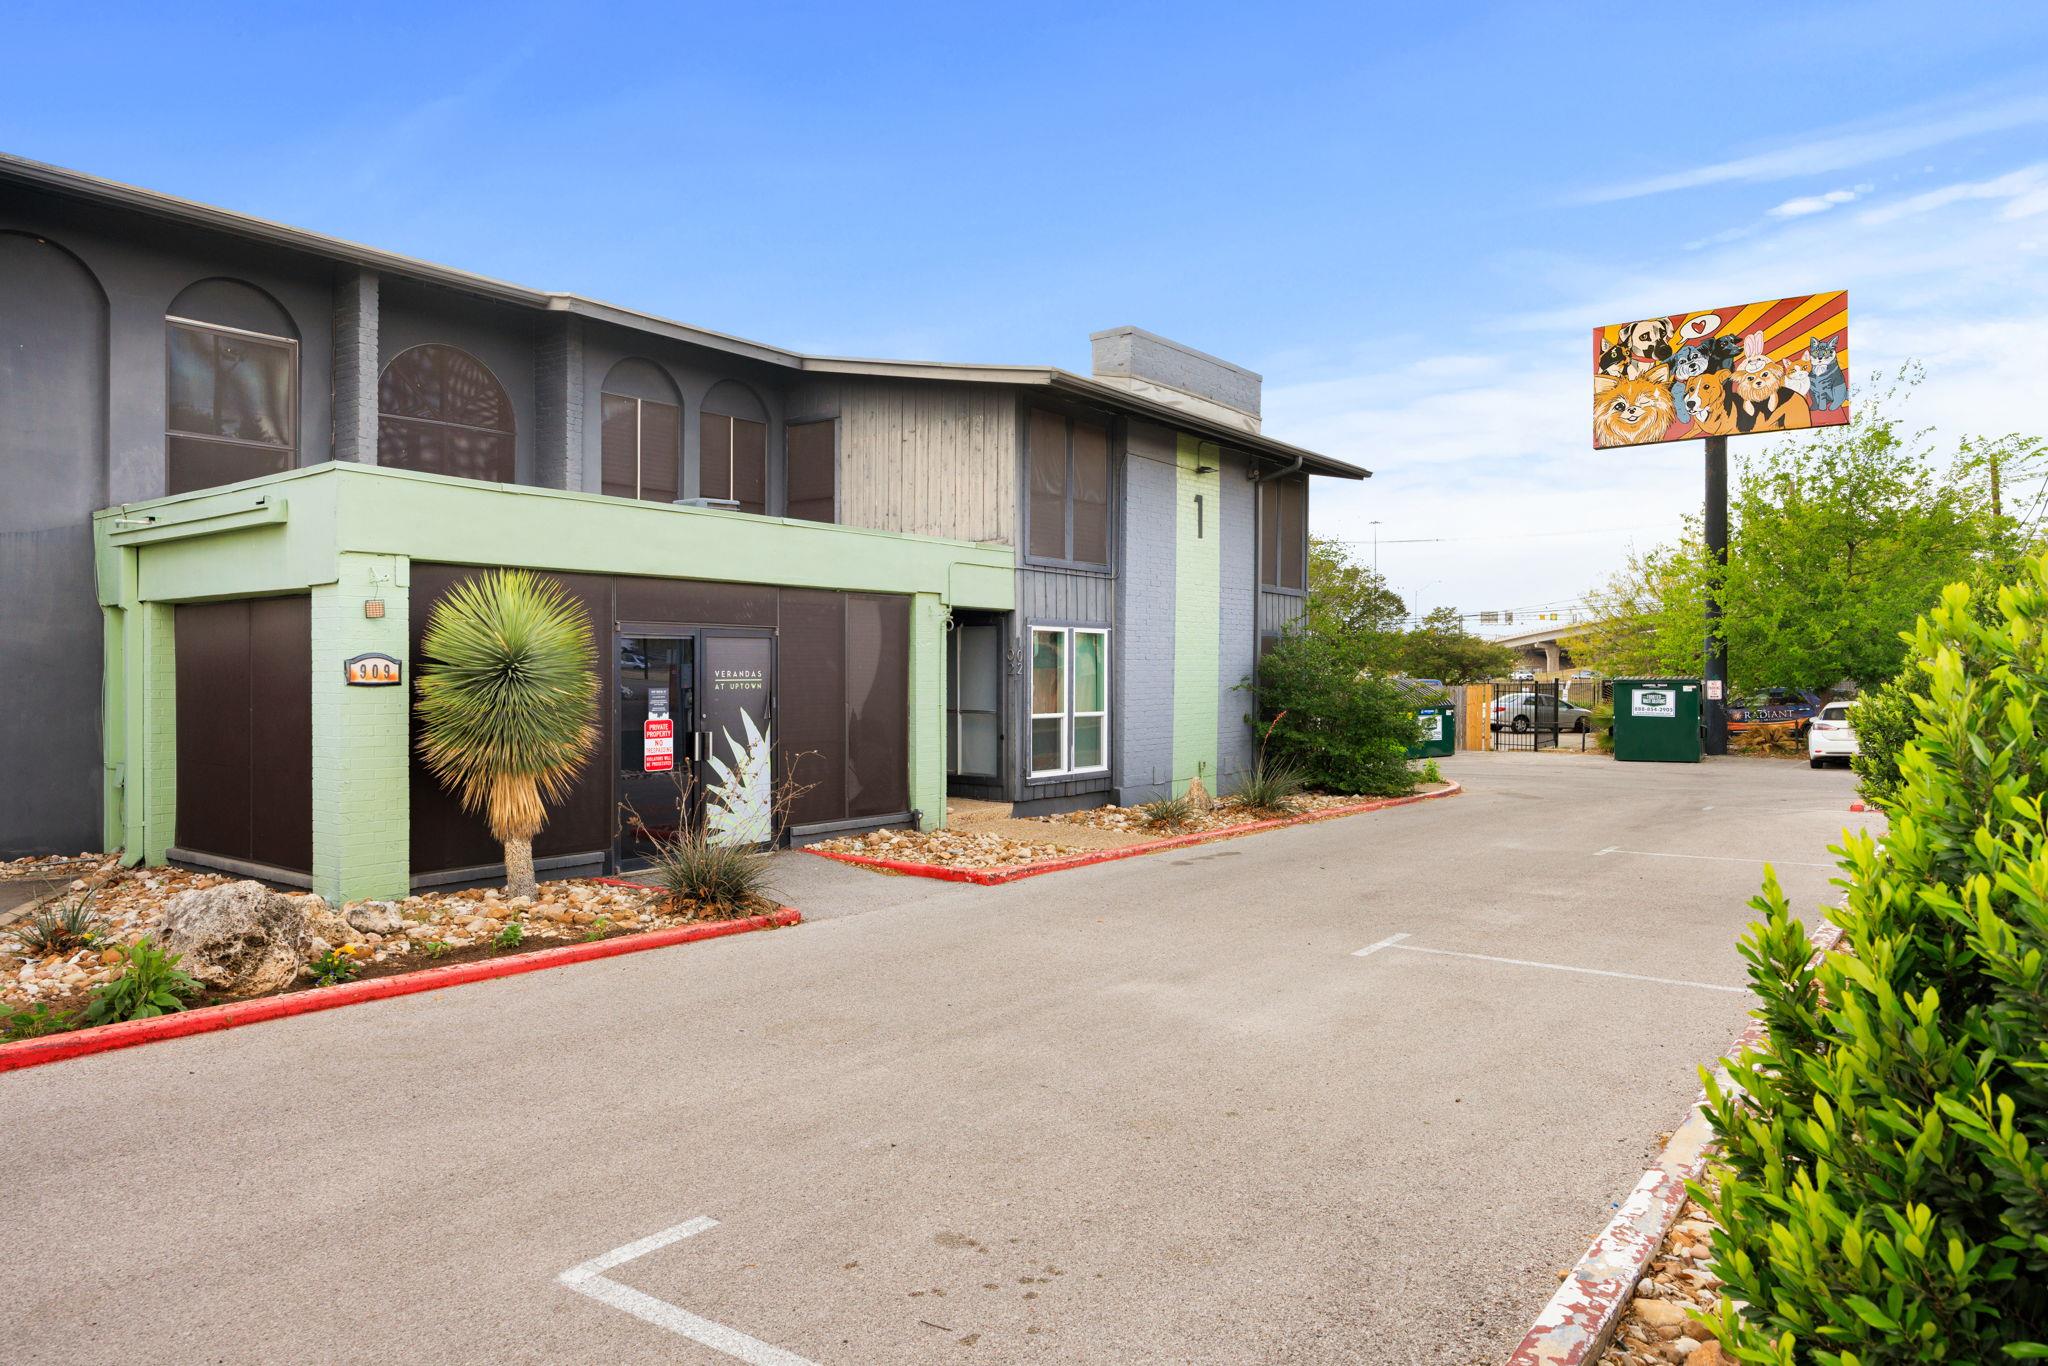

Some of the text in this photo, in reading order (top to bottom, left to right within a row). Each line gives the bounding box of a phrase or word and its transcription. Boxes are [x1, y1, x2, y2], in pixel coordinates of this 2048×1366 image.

[1193, 494, 1203, 539] 1
[360, 664, 390, 679] 909
[714, 670, 762, 678] VERANDAS
[730, 682, 762, 690] UPTOWN
[1744, 709, 1795, 720] RADIANT
[649, 723, 669, 731] PRIVATE
[646, 730, 671, 738] PROPERTY
[654, 739, 664, 747] NO
